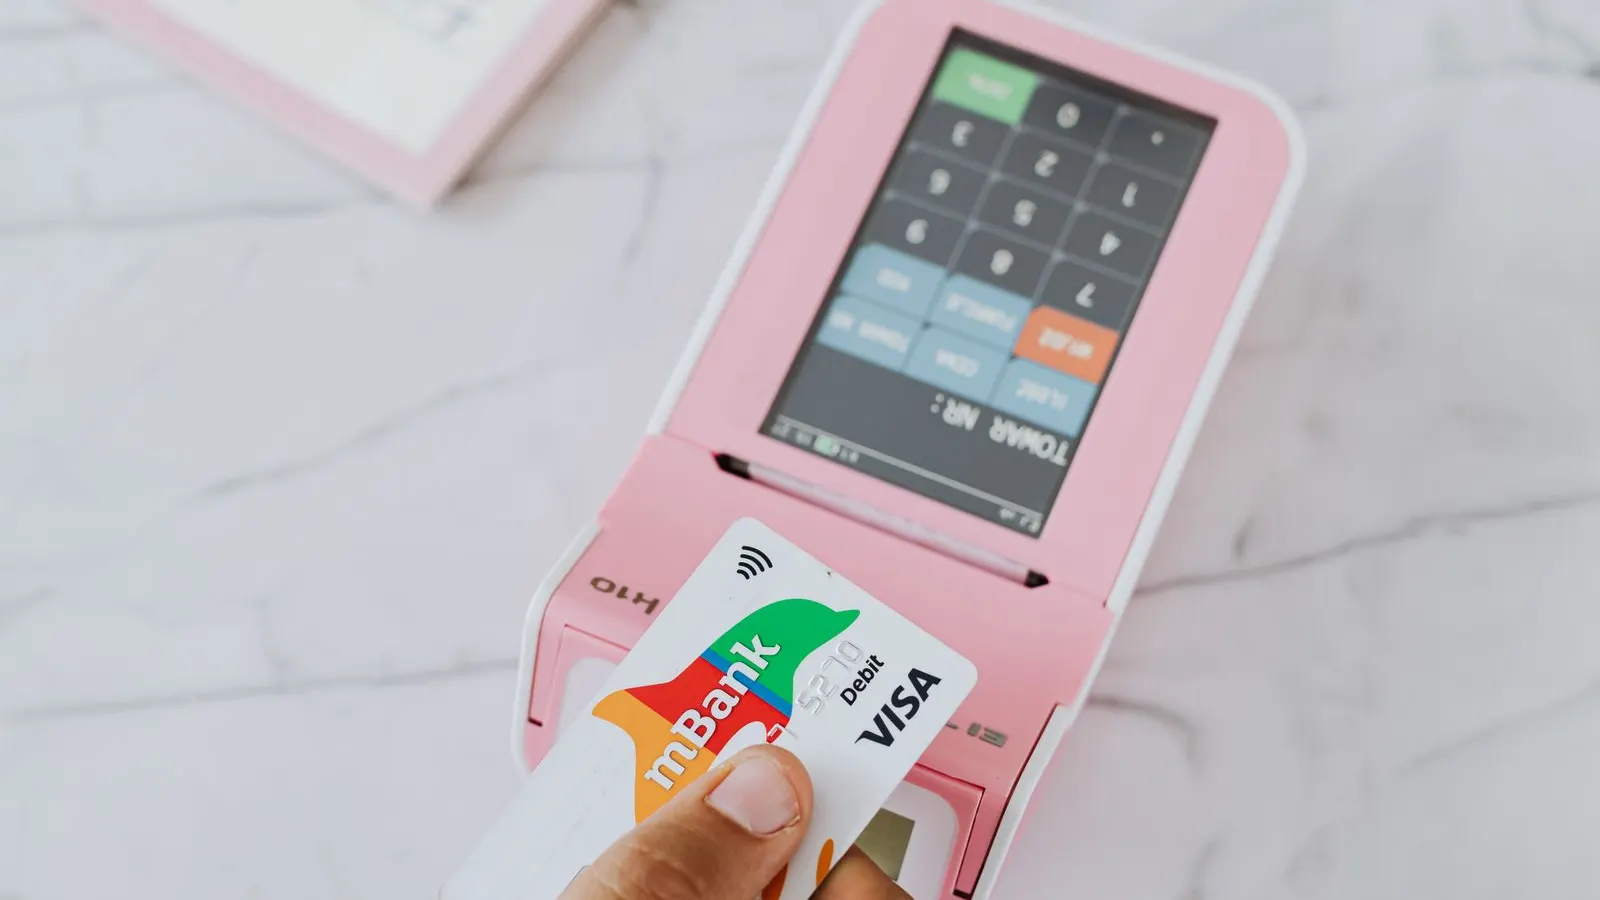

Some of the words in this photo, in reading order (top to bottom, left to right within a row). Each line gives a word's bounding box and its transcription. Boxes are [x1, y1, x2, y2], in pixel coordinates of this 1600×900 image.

[951, 120, 975, 147] 3
[1034, 150, 1060, 177] 2
[929, 168, 951, 195] 6
[1121, 181, 1139, 208] 1
[1013, 199, 1037, 226] 5
[905, 218, 929, 244] 9
[1099, 231, 1121, 257] 4
[990, 249, 1014, 275] 8
[1076, 282, 1097, 308] 7
[930, 393, 981, 431] NR:
[989, 415, 1069, 467] TOWAR
[796, 640, 864, 716] 5270
[840, 654, 885, 707] Debit
[644, 634, 781, 791] mBank
[854, 667, 942, 747] VISA
